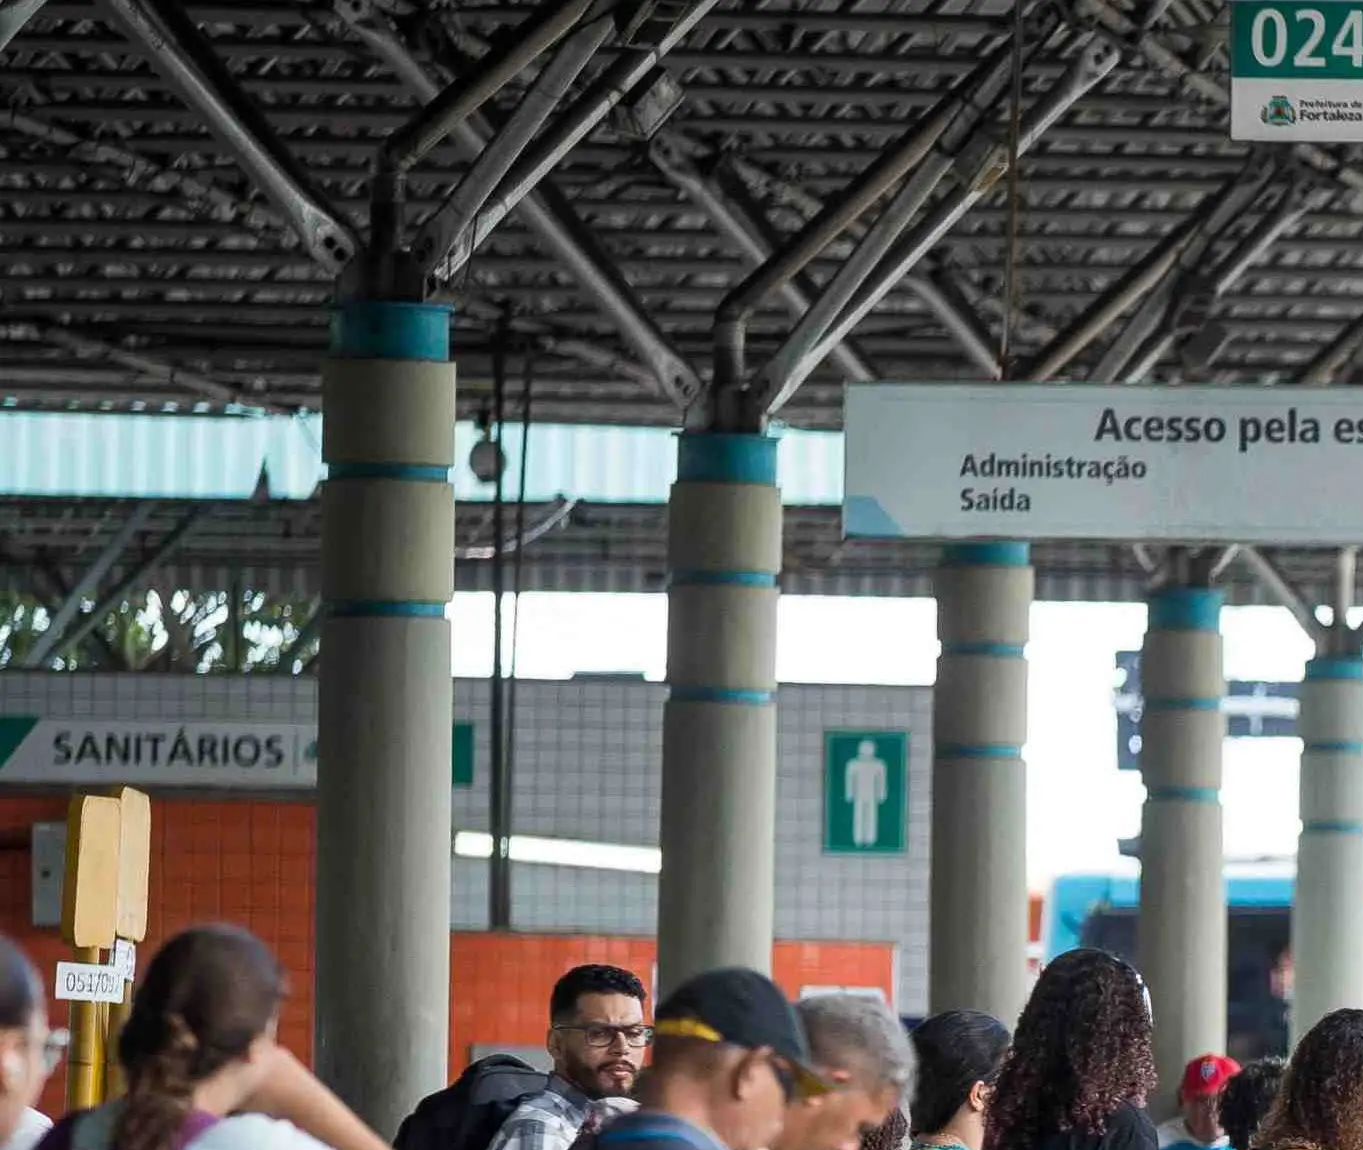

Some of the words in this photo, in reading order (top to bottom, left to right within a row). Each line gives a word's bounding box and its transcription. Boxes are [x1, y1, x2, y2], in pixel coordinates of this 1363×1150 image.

[1299, 109, 1363, 121] Fortaleza
[1094, 408, 1227, 443] Acesso
[1238, 408, 1321, 452] pela
[960, 454, 1147, 485] Administração
[960, 488, 1031, 512] Saída
[53, 726, 284, 768] SANITÁRIOS
